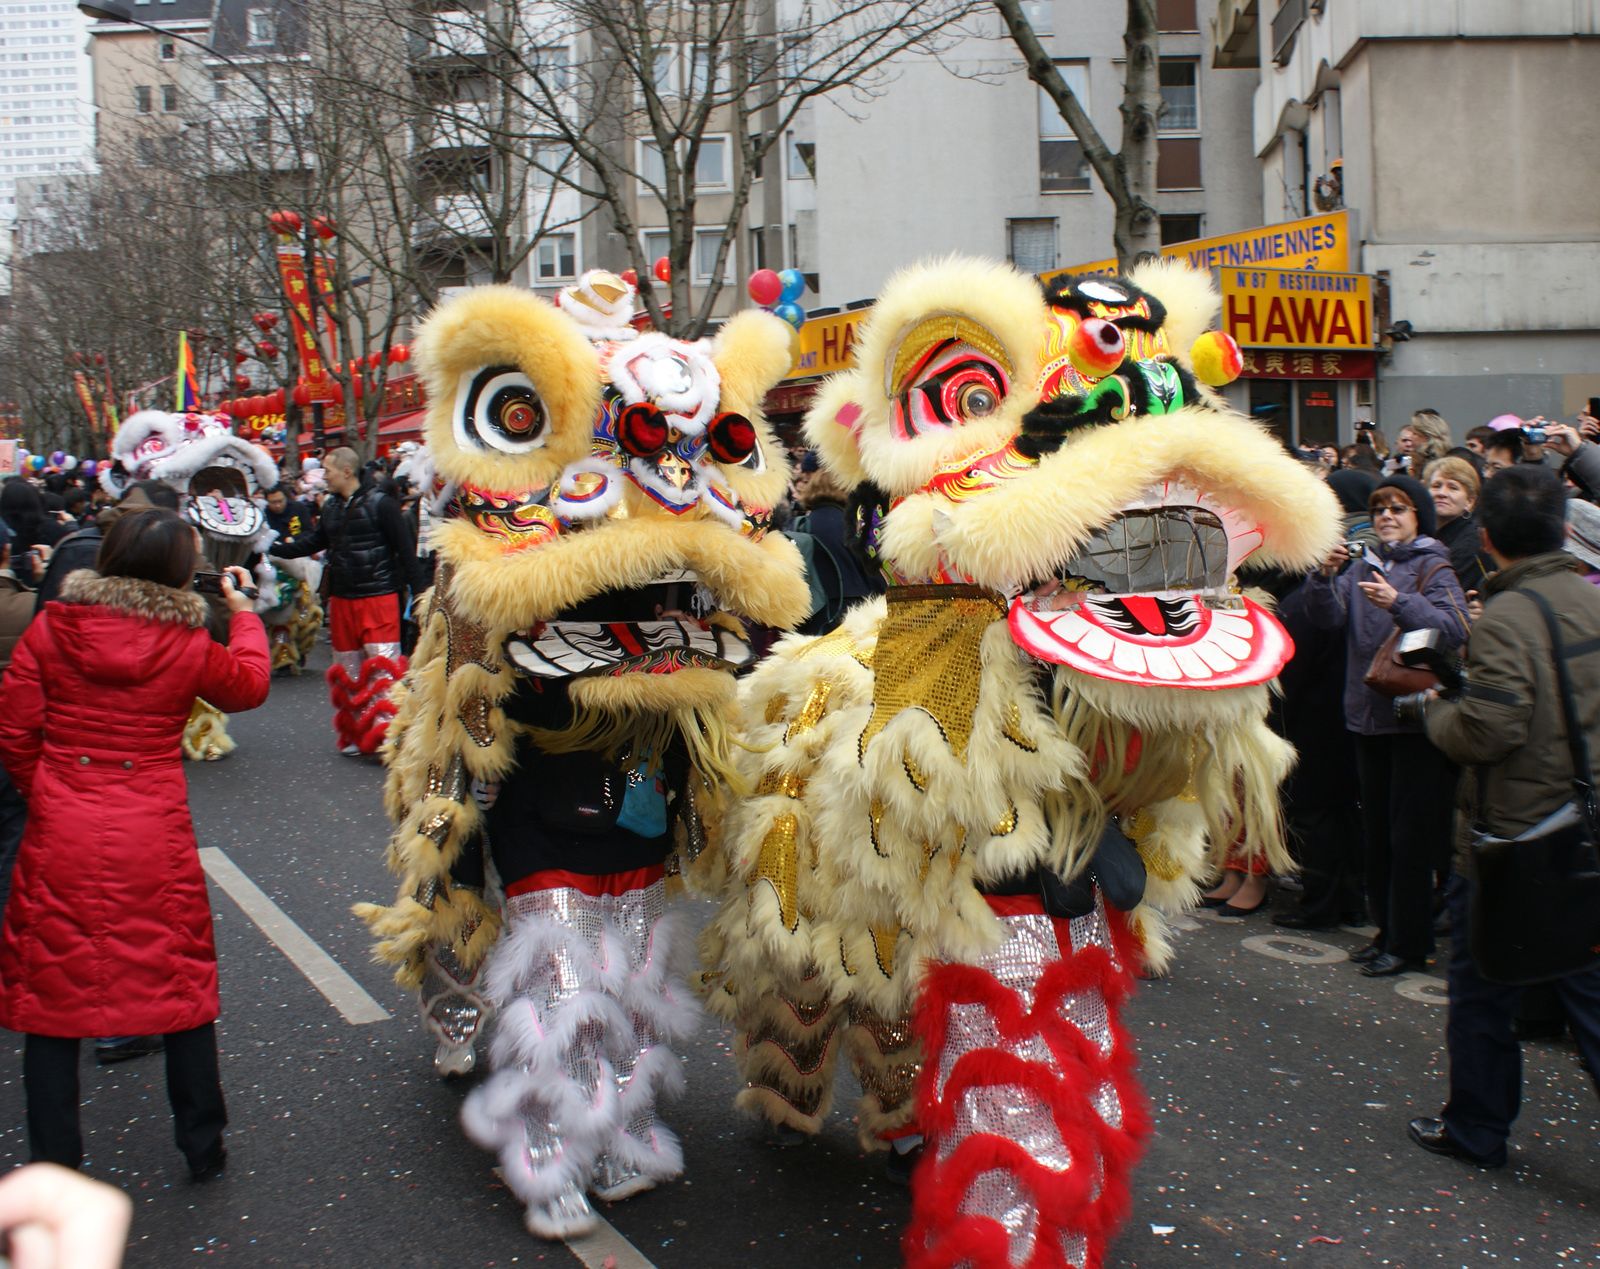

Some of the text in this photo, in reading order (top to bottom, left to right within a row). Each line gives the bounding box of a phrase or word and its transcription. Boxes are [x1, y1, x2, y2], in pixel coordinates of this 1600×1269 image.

[1189, 223, 1336, 269] VIETNAMIENNES
[1279, 273, 1359, 292] RESTAURANT
[1228, 294, 1368, 345] HAWAI
[823, 320, 863, 366] HA
